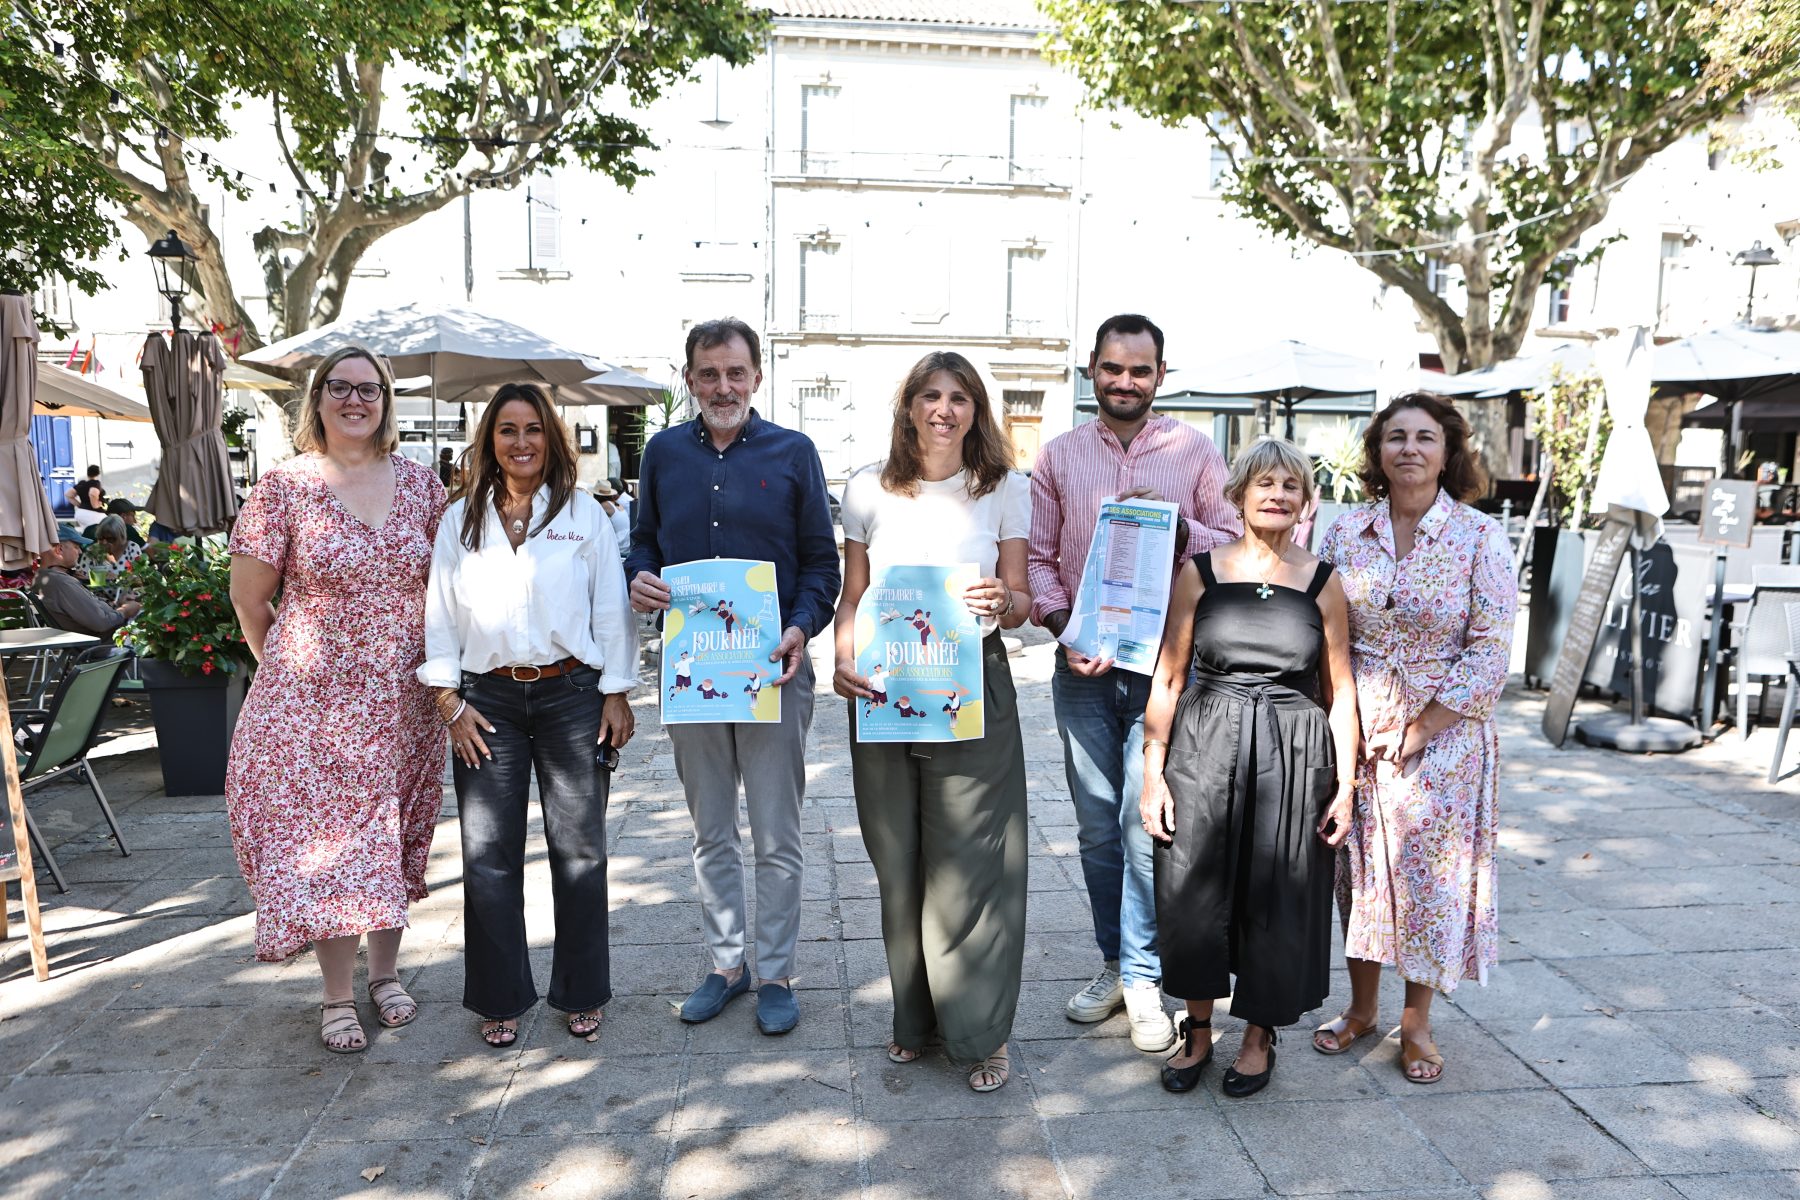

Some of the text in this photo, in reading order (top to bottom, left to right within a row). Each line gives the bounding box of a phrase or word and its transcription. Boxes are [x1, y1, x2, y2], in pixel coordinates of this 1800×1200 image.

[1121, 507, 1162, 519] ASSOCIATIONS
[547, 529, 567, 540] Dolce
[677, 581, 718, 597] SEPTEMBRE
[872, 588, 915, 601] SEPTEMBRE
[1605, 601, 1692, 649] LIIER
[692, 623, 761, 656] JOURNÉE
[710, 650, 753, 661] ASSOCIATIONS
[885, 636, 959, 668] JOURNÉE
[1605, 645, 1664, 671] BISTOT
[906, 667, 953, 677] ASSOCIATIONS
